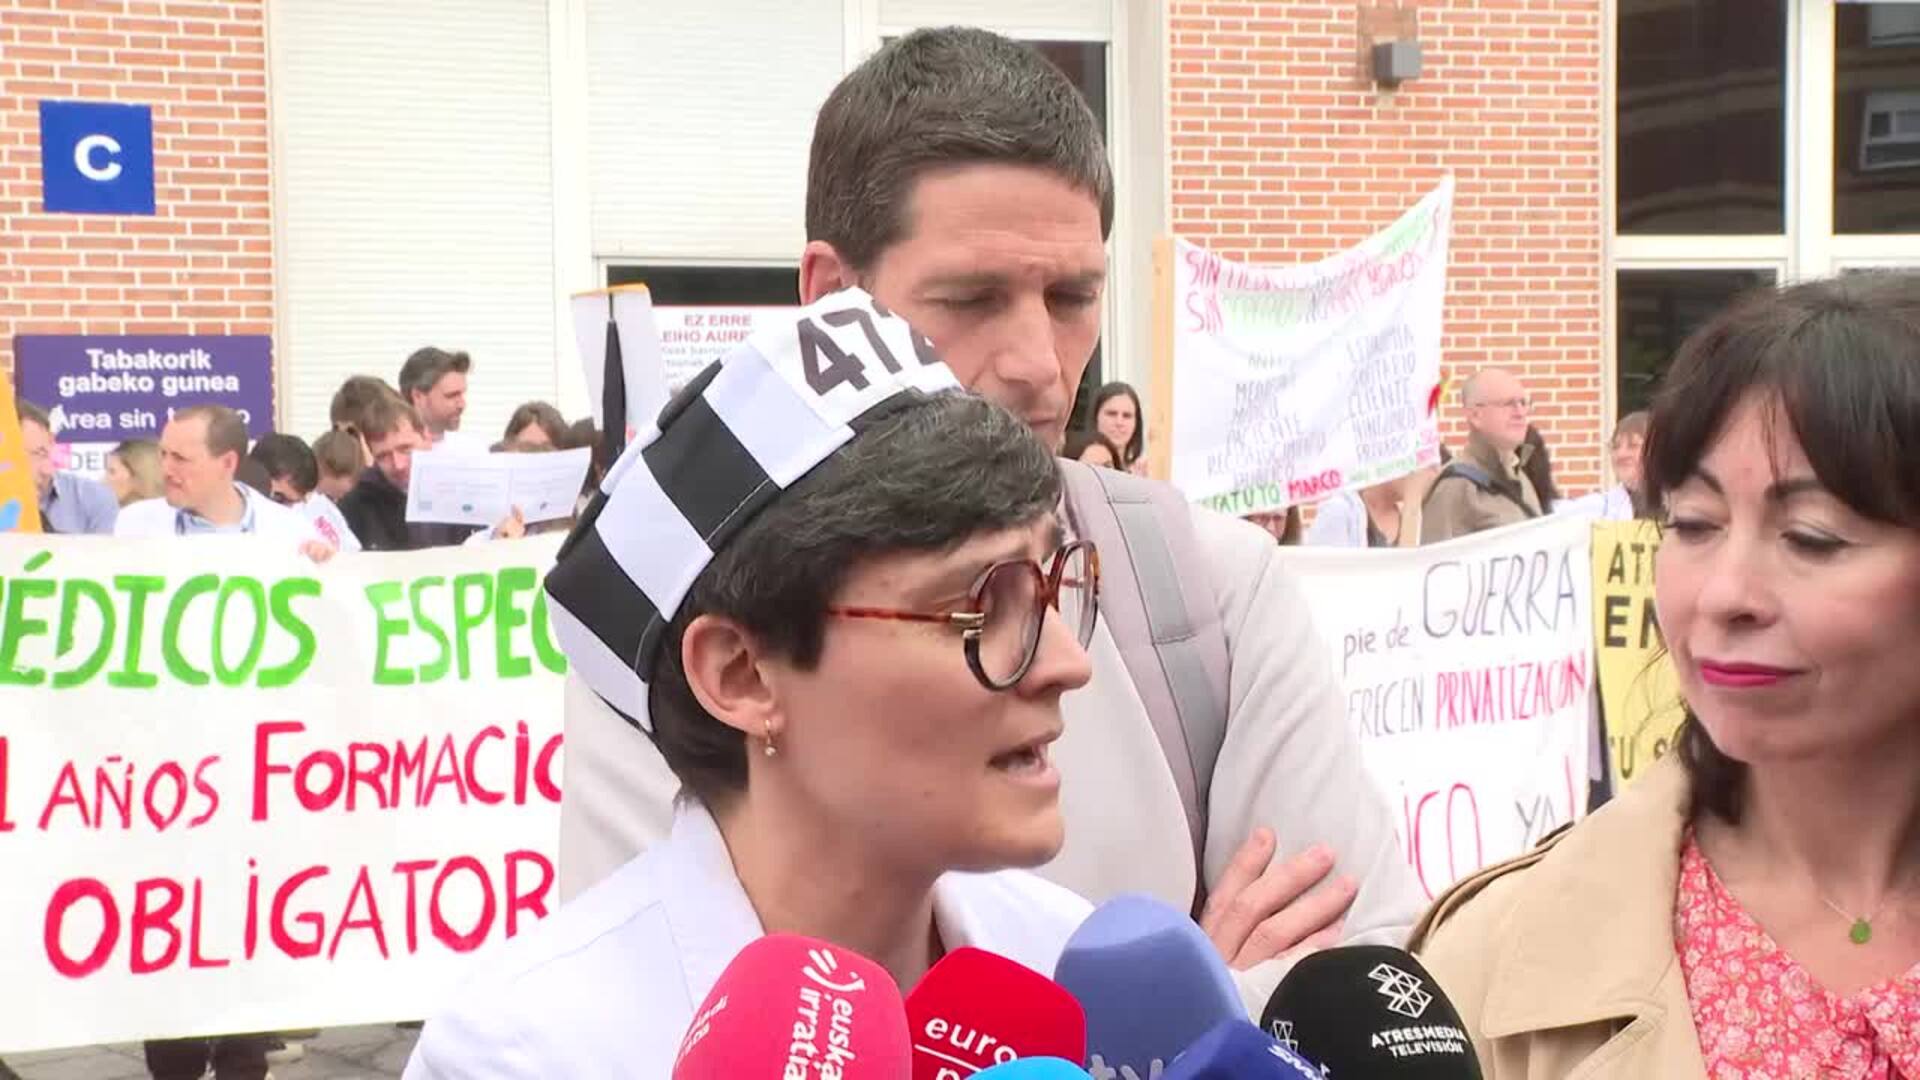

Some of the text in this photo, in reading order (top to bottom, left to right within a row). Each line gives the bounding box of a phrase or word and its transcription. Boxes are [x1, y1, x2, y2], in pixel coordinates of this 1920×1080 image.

[74, 135, 122, 181] C
[708, 314, 752, 326] ERRE
[660, 330, 701, 343] EIHO
[85, 348, 213, 371] Tabakorik
[58, 371, 240, 397] gabeko gunea
[119, 408, 156, 428] sin
[1287, 469, 1342, 499] MARCO
[0, 550, 321, 688] ÉDICOS
[1343, 549, 1578, 677] pie de GUERRA
[38, 754, 220, 832] AÑOS
[924, 1016, 1018, 1065] euro
[1371, 1025, 1468, 1049] ATRESMEDIA
[1388, 1040, 1465, 1059] TELEVISIÓN
